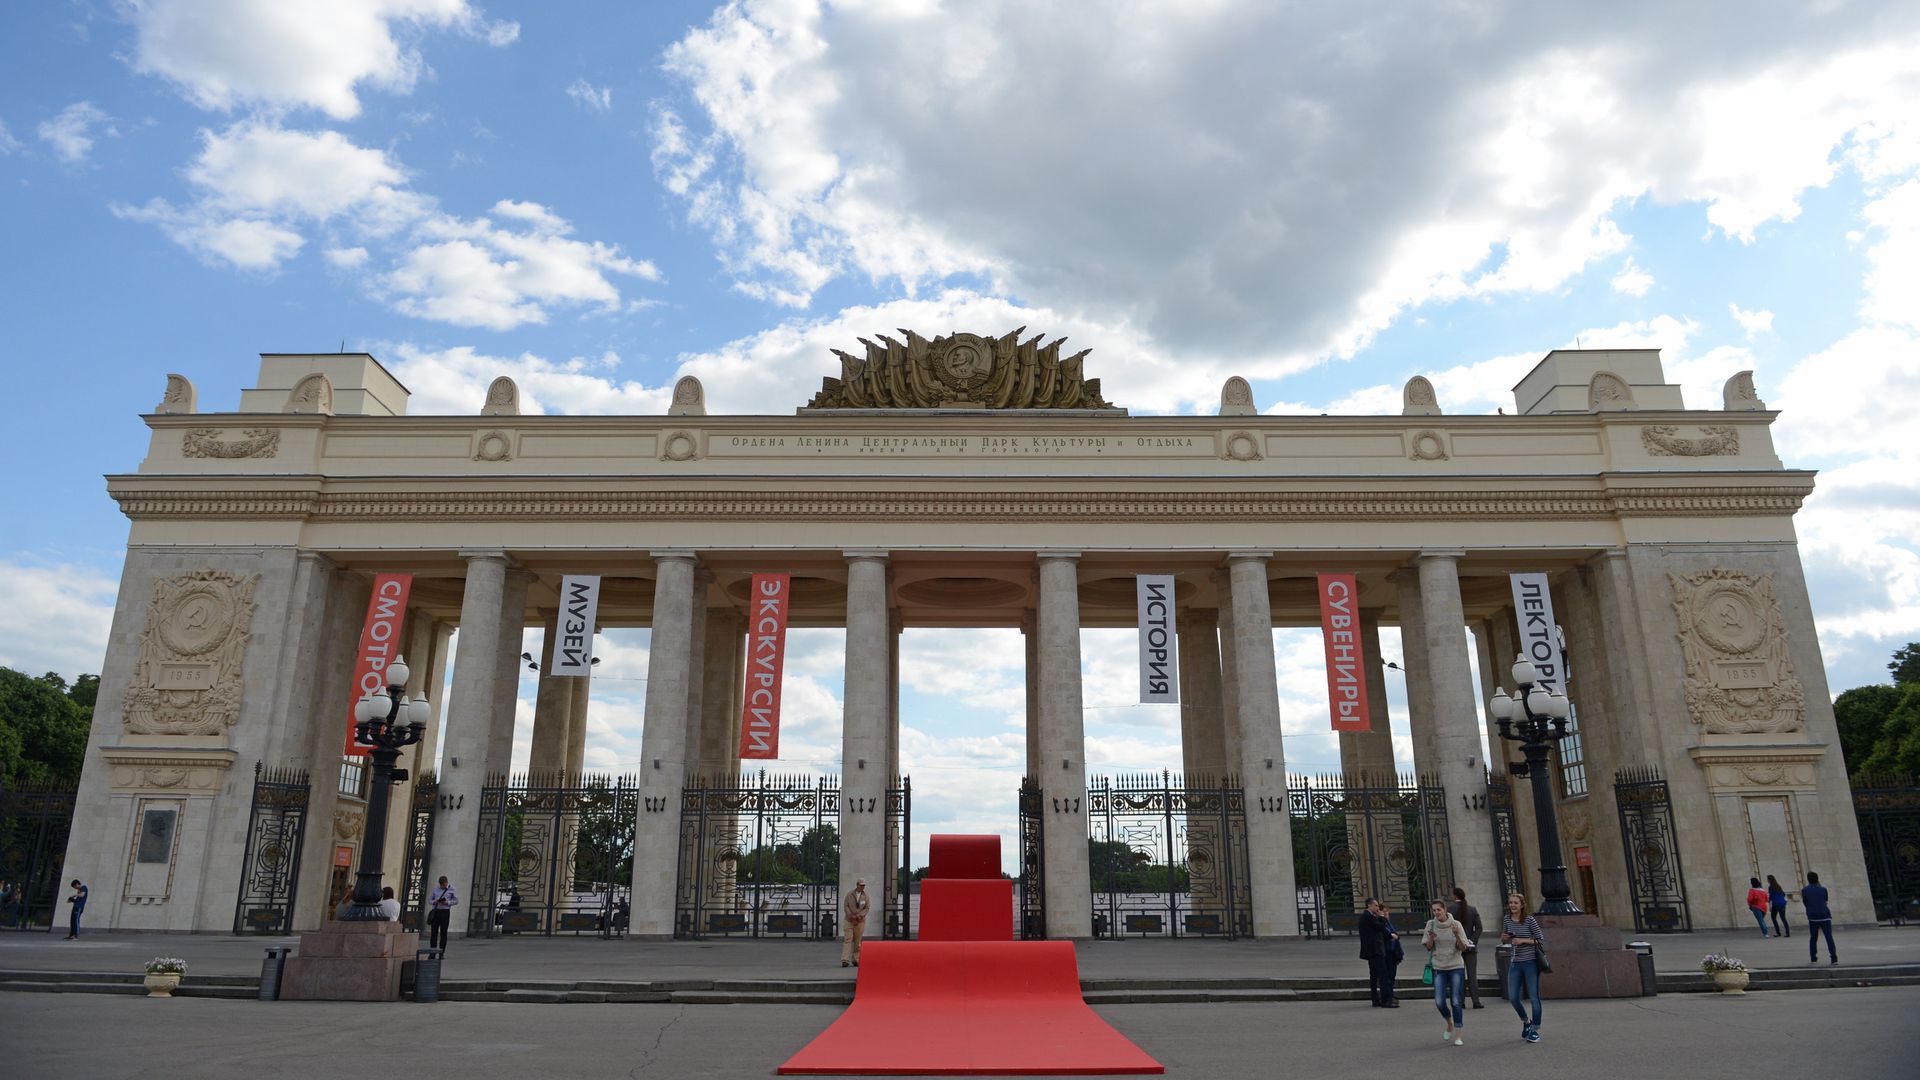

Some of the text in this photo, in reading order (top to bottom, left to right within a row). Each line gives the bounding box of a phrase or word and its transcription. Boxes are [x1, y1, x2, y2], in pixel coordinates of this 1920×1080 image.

[732, 436, 785, 447] ОРДЕНА
[797, 436, 849, 447] ЛЕНИНА
[982, 436, 1018, 447] ПАРК
[1033, 436, 1105, 447] КУЛЬТУРЫ
[1137, 436, 1193, 447] ОТДЫХА
[561, 582, 590, 667] МУЗЕЙ
[749, 580, 781, 750] ЭКСКУРСИИ
[1146, 583, 1169, 695] ИСТОРИЯ
[1327, 581, 1361, 722] СУВЕНИРЫ
